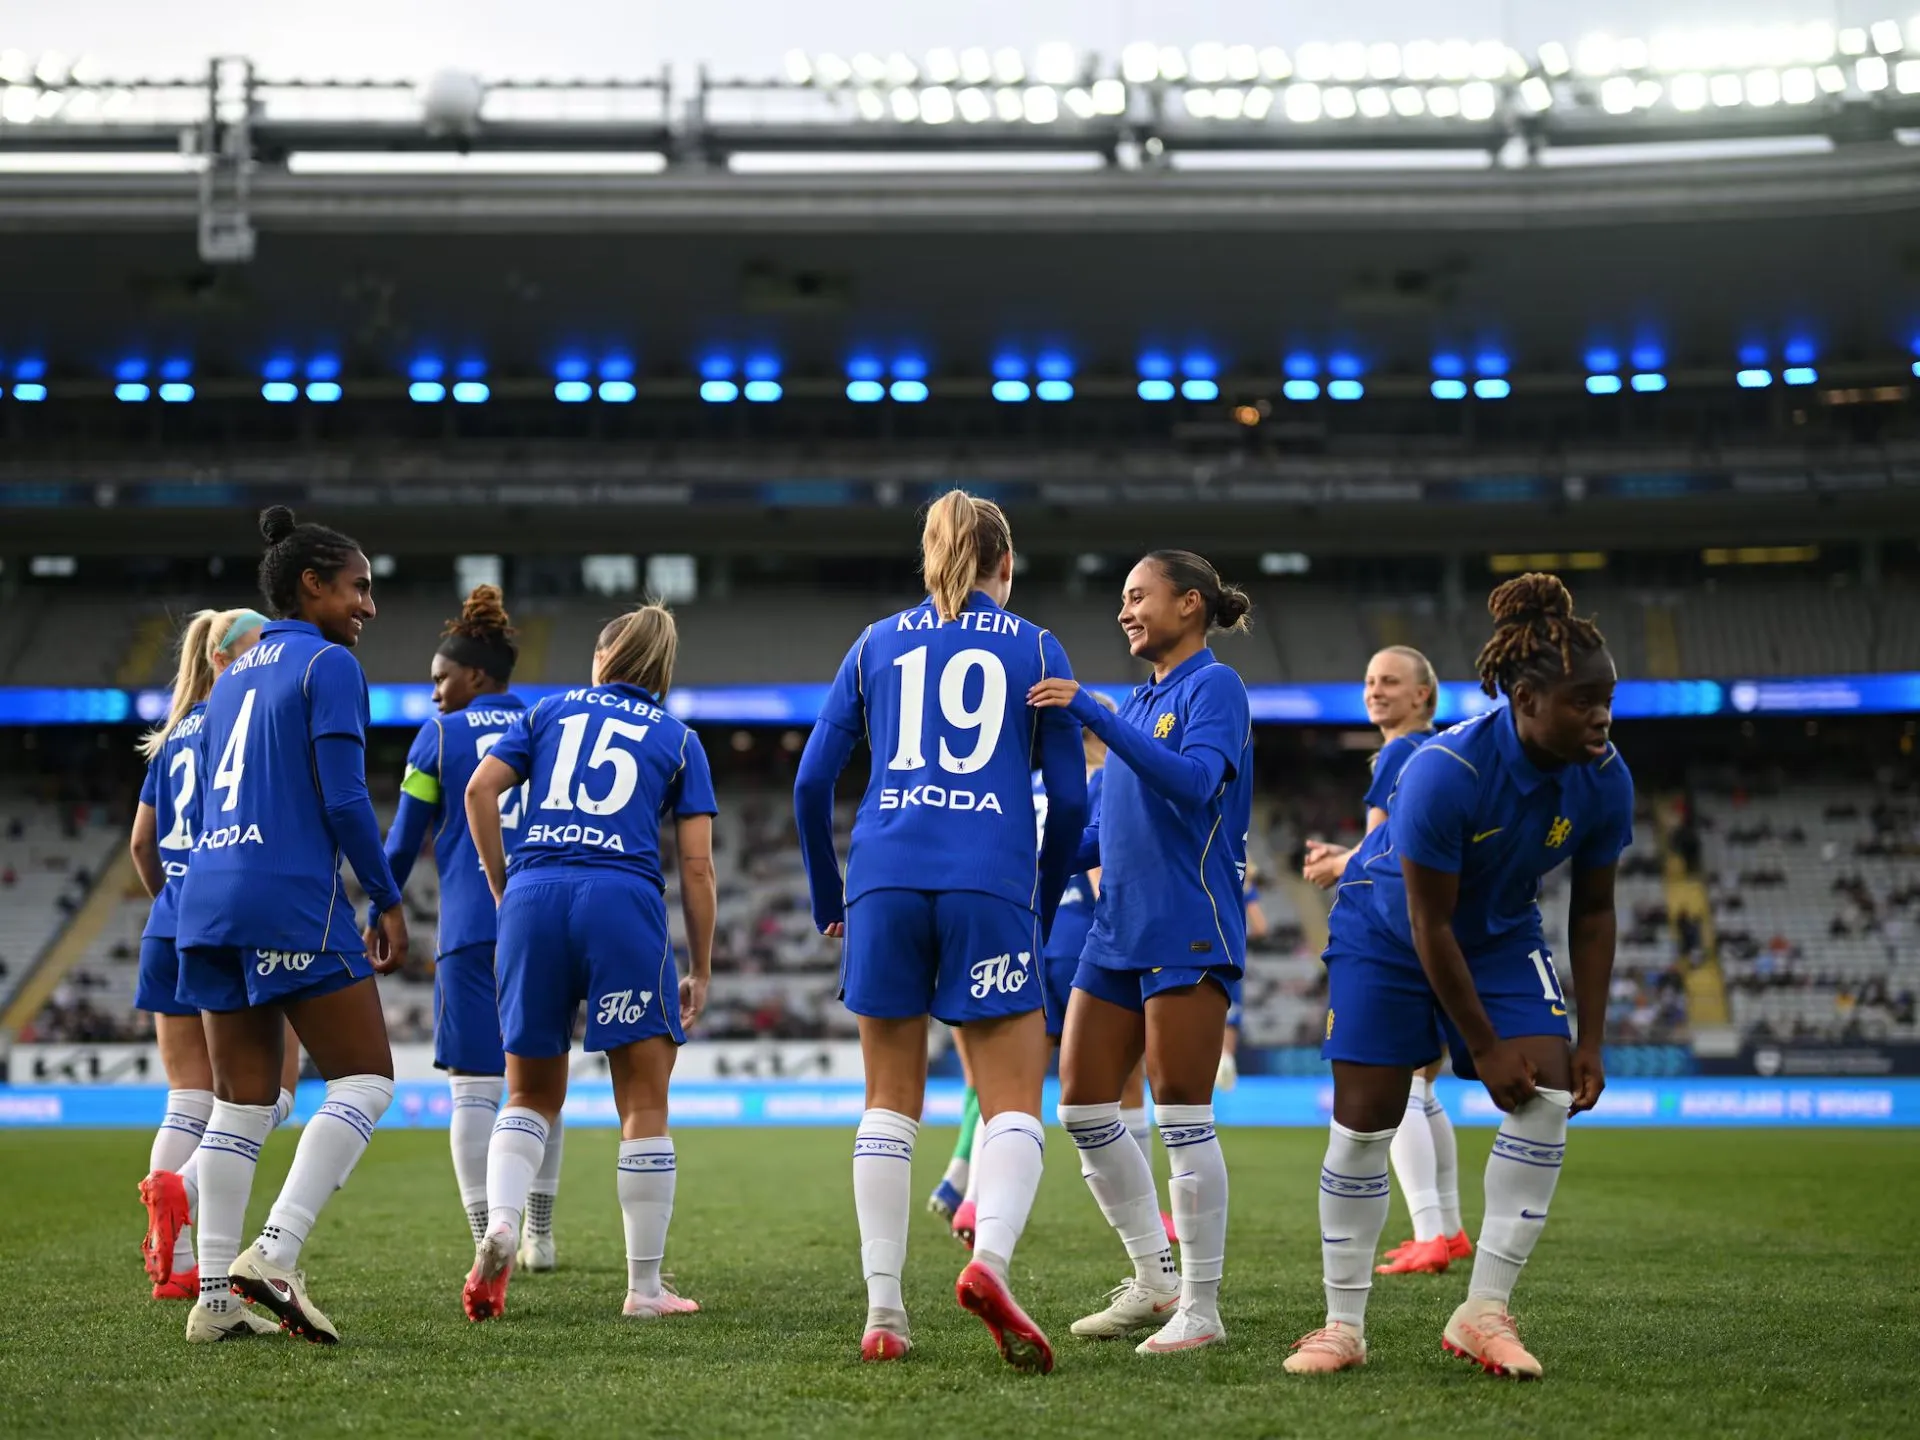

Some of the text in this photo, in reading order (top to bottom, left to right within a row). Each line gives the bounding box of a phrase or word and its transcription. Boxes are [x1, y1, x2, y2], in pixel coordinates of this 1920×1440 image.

[231, 643, 285, 676] GIRMA
[888, 645, 1007, 774] 19
[213, 688, 256, 812] 4
[540, 712, 649, 816] 15
[159, 747, 195, 851] 2
[596, 989, 647, 1025] Flo
[970, 952, 1030, 999] Flo
[865, 1142, 899, 1152] CFC
